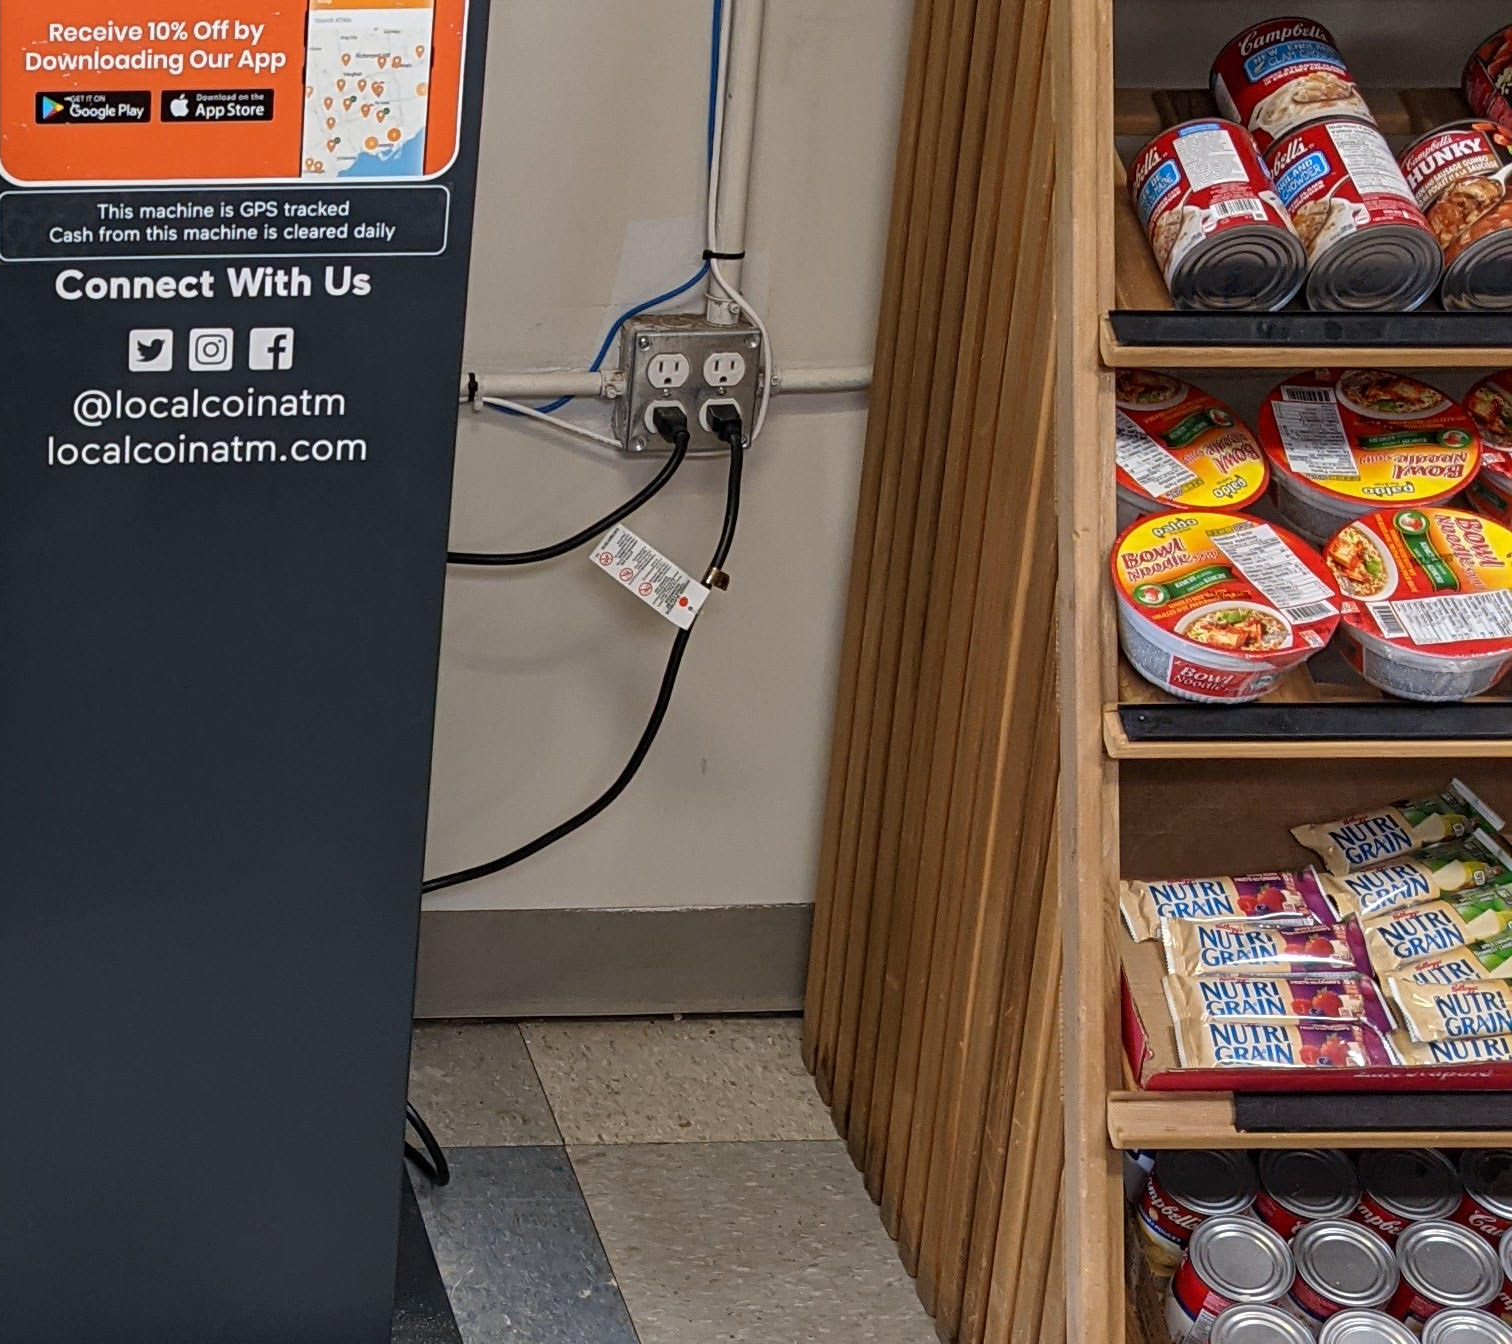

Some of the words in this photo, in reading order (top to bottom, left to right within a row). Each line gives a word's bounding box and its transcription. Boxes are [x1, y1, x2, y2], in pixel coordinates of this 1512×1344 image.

[49, 22, 143, 43] Receive
[148, 20, 188, 42] 10%
[193, 19, 230, 41] Off
[234, 20, 265, 45] by
[1239, 23, 1327, 56] Campbell's
[25, 49, 184, 76] Downloading
[189, 49, 233, 69] Our
[237, 50, 286, 75] App
[251, 93, 264, 101] the
[70, 104, 115, 120] Google
[118, 104, 144, 119] Play
[195, 104, 225, 119] App
[227, 103, 264, 116] Store
[1407, 138, 1482, 190] HUNKY
[97, 203, 134, 219] This
[139, 202, 214, 218] machine
[220, 201, 234, 217] is
[239, 201, 278, 217] GPS
[284, 200, 350, 217] tracked
[49, 226, 93, 243] Cash
[98, 225, 140, 243] from
[146, 225, 178, 241] this
[183, 224, 257, 240] machine
[263, 224, 278, 239] is
[283, 222, 348, 239] cleared
[353, 222, 396, 242] daily
[55, 269, 215, 301] Connect
[227, 266, 312, 299] With
[324, 265, 372, 297] Us
[73, 387, 347, 427] @localcoinatm
[48, 434, 368, 466] localcoinatm.com
[1213, 474, 1248, 498] paldo
[1362, 482, 1416, 497] paldo
[1152, 517, 1198, 538] paldo
[1328, 814, 1400, 850] NUTRI
[1345, 828, 1413, 865] GRAIN
[1345, 863, 1419, 896] NUTRI
[1360, 873, 1430, 912] GRAIN
[1148, 880, 1226, 906] NUTRI
[1157, 895, 1235, 919] GRAIN
[1198, 926, 1274, 949] NUTRI
[1377, 909, 1453, 948] NUTRI
[1393, 924, 1465, 959] GRAIN
[1201, 943, 1279, 967] GRAIN
[1199, 981, 1281, 1002] NUTRI
[1434, 991, 1507, 1018] NUTRI
[1205, 998, 1287, 1017] GRAIN
[1209, 1023, 1291, 1047] NUTRI
[1444, 1010, 1512, 1036] GRAIN
[1214, 1043, 1294, 1066] GRAIN
[1429, 1037, 1510, 1063] NUTRI
